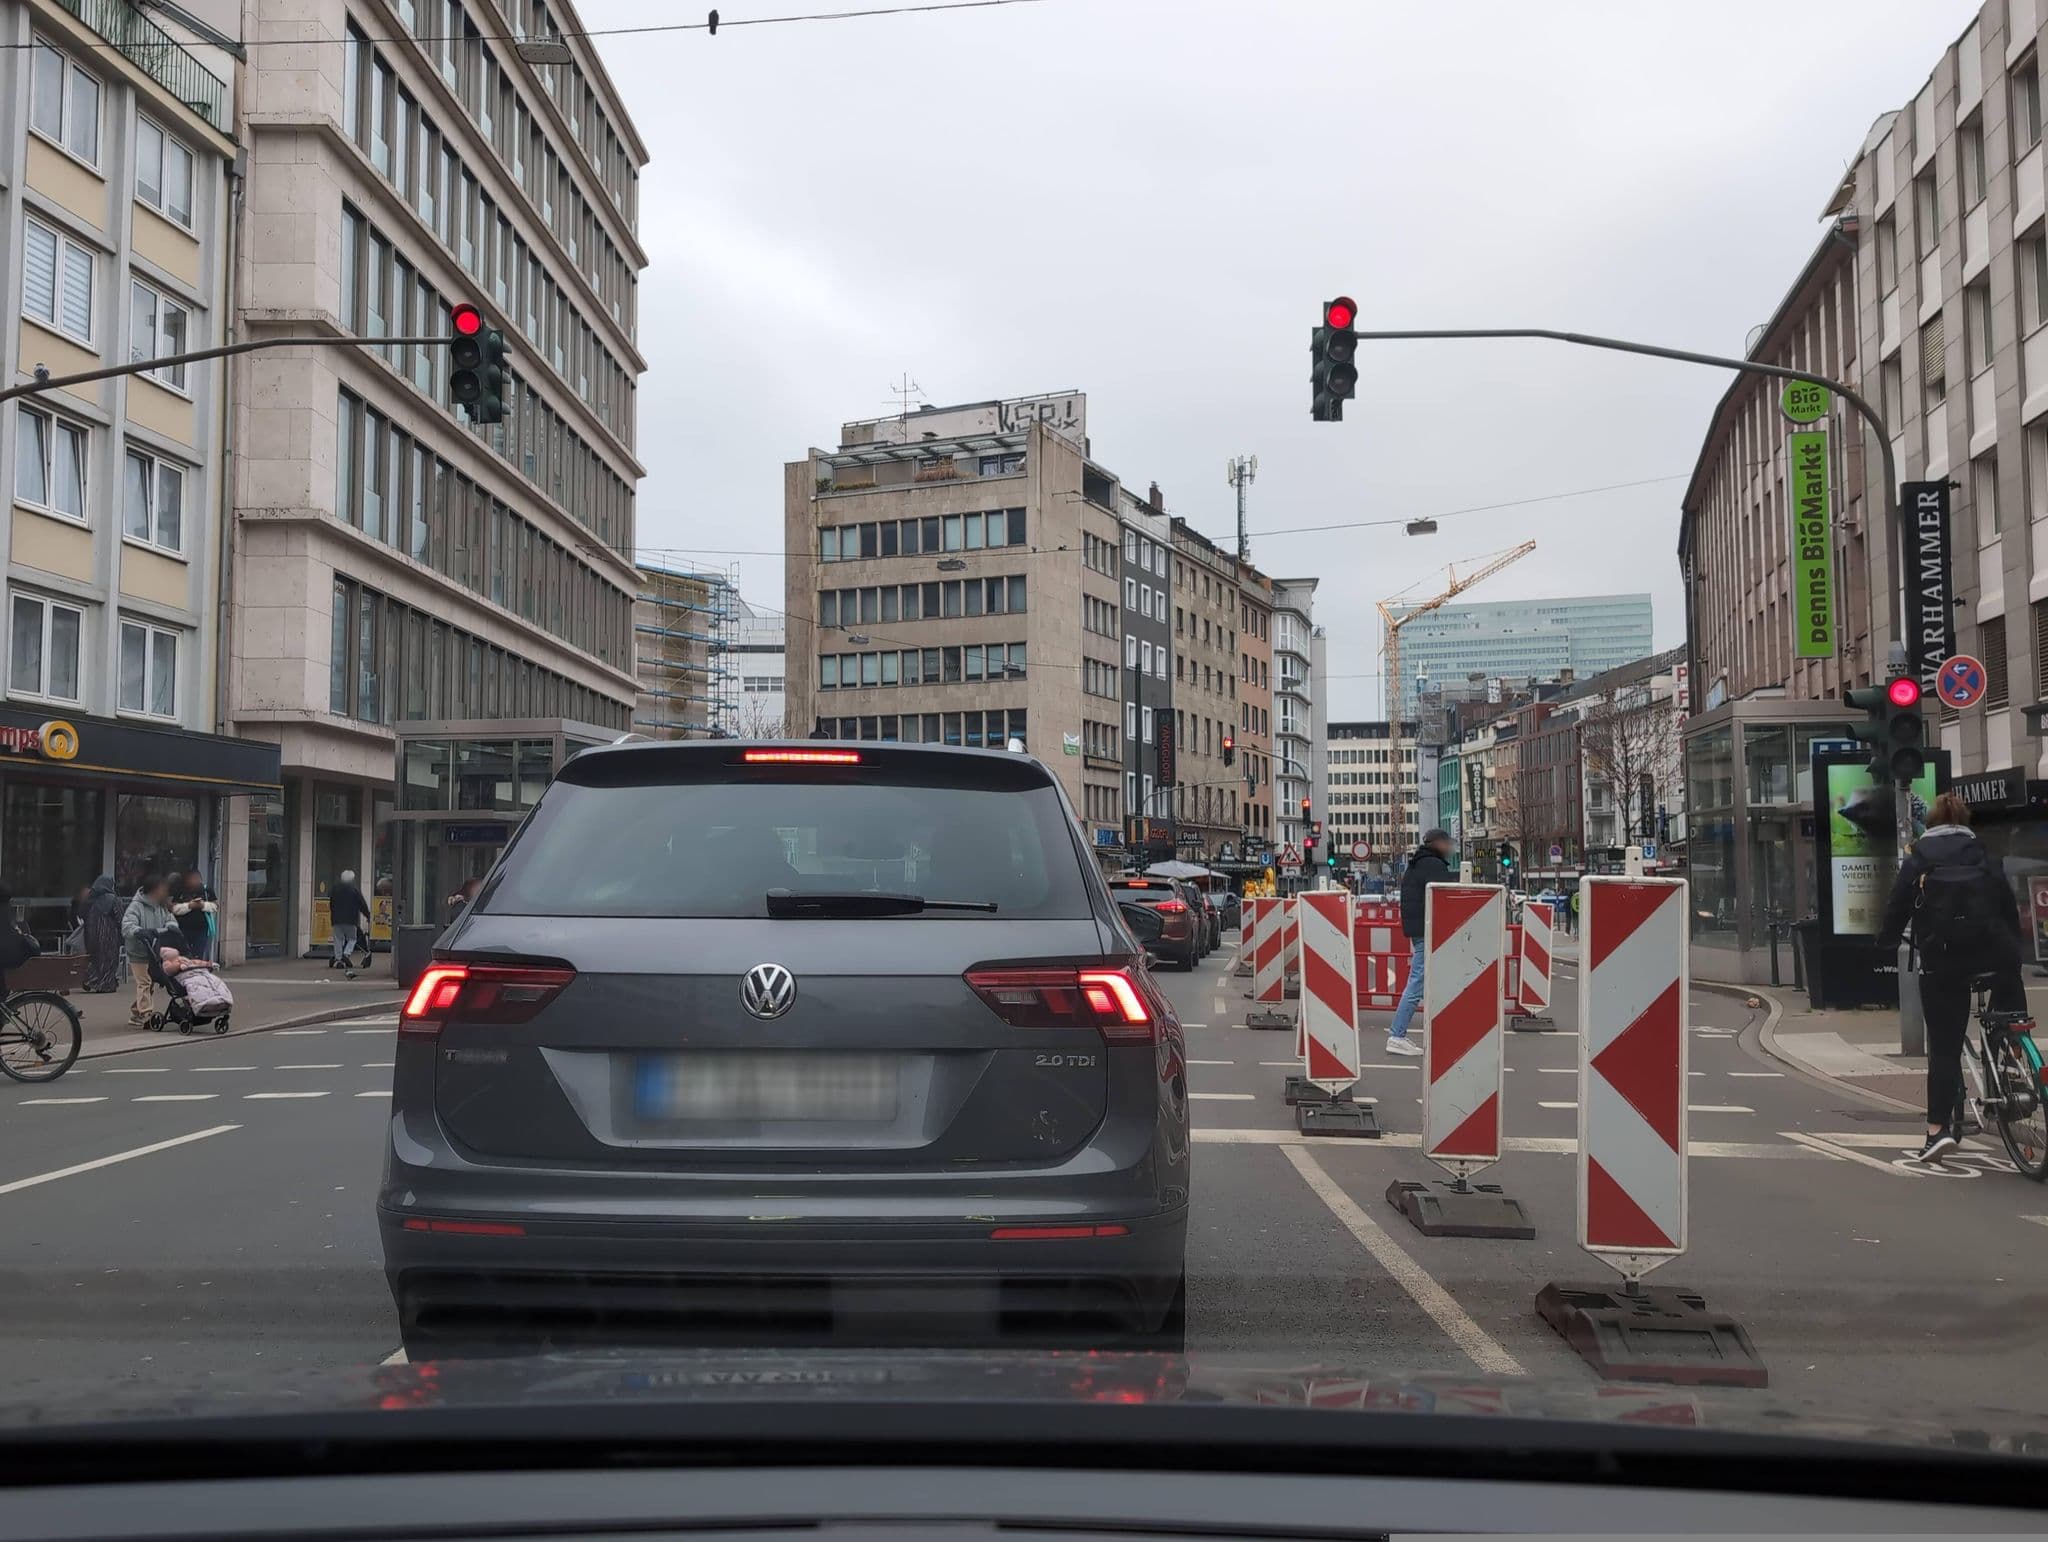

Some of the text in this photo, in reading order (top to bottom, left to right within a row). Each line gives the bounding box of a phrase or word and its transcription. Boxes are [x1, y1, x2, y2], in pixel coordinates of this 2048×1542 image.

[1791, 404, 1821, 415] Markt
[1917, 490, 1946, 694] WARHAMMER
[1952, 779, 2008, 804] HAMMER
[1183, 831, 1198, 841] Post
[1841, 864, 1871, 872] DAMIT
[1034, 1055, 1096, 1067] 2.0 TDI
